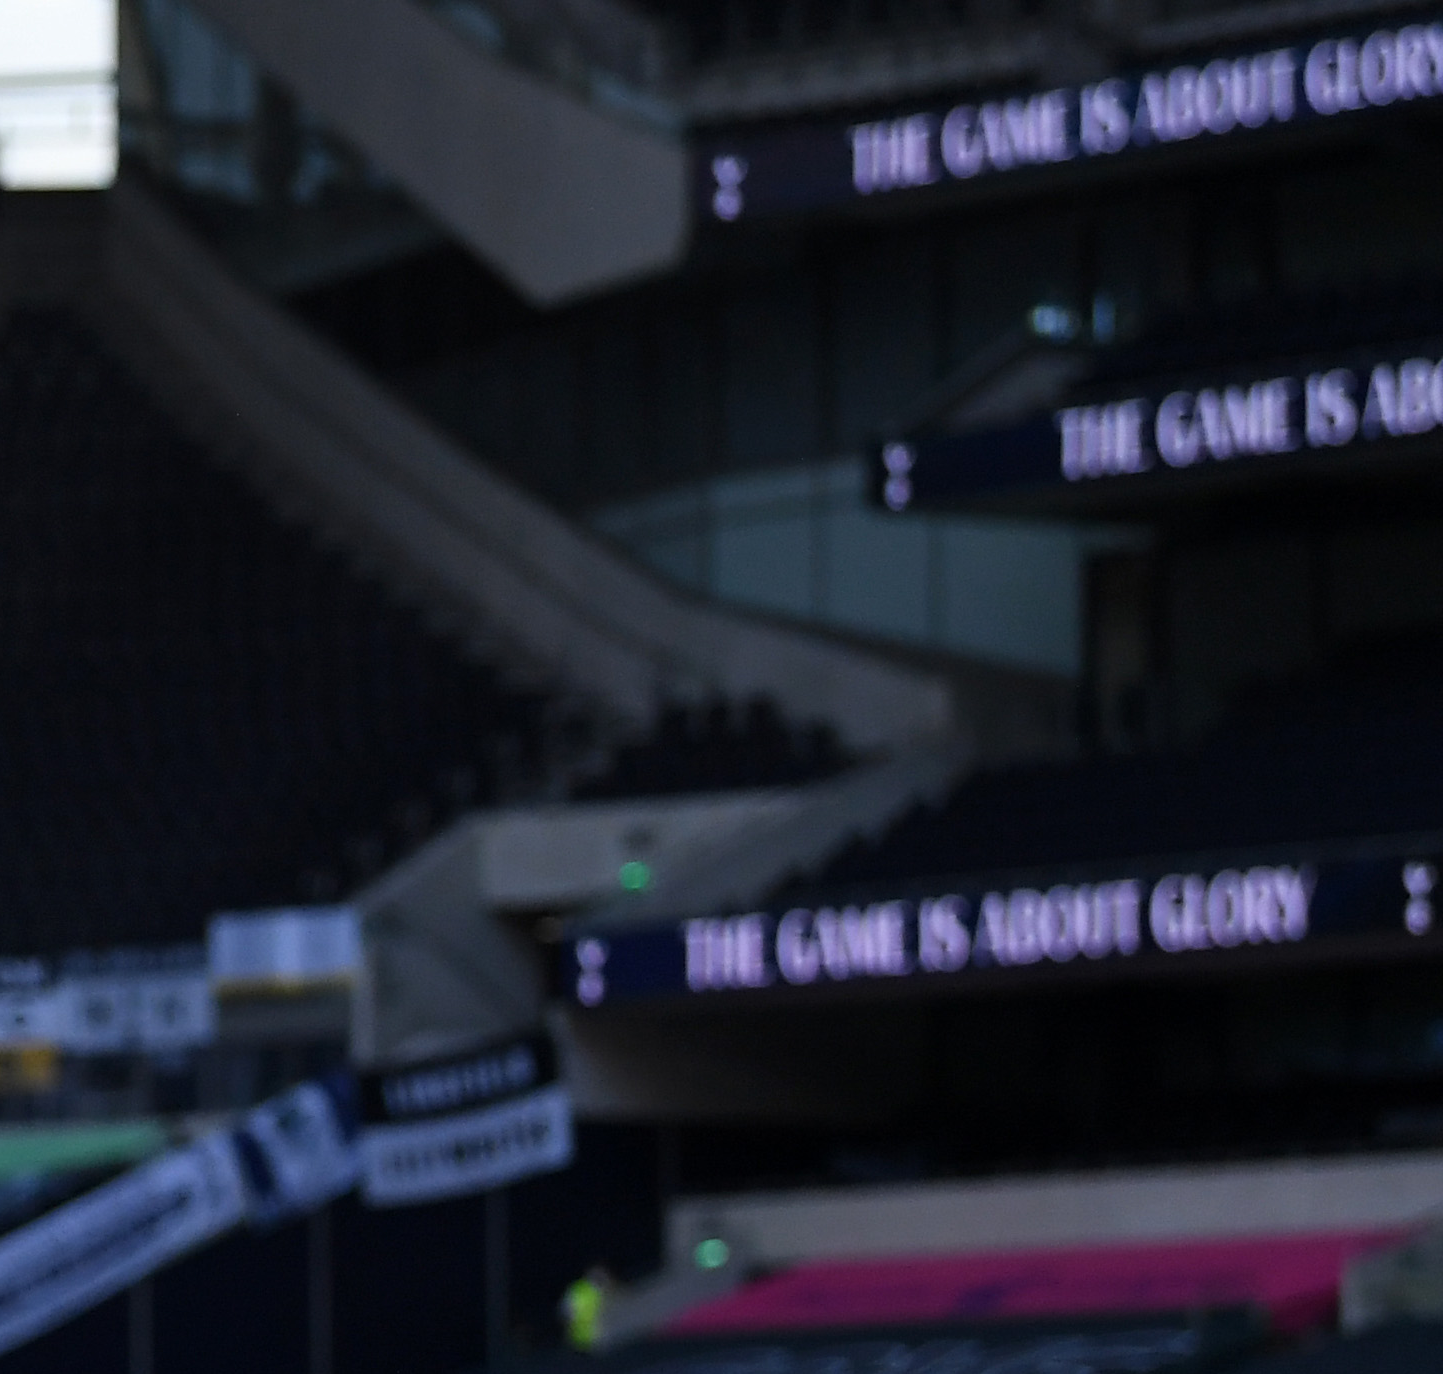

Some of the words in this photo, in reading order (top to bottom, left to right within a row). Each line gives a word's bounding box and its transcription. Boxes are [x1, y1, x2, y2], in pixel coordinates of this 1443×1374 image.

[849, 112, 939, 194] THE
[941, 88, 1075, 178] GAME
[1080, 78, 1129, 154] IS
[1131, 48, 1295, 147] ABOUT
[1056, 398, 1153, 482] THE
[1155, 377, 1302, 468] GAME
[1305, 367, 1358, 447] IS
[681, 912, 775, 992] THE
[776, 899, 914, 985] GAME
[918, 895, 971, 973] IS
[973, 878, 1141, 968] ABOUT
[1149, 864, 1315, 952] GLORY
